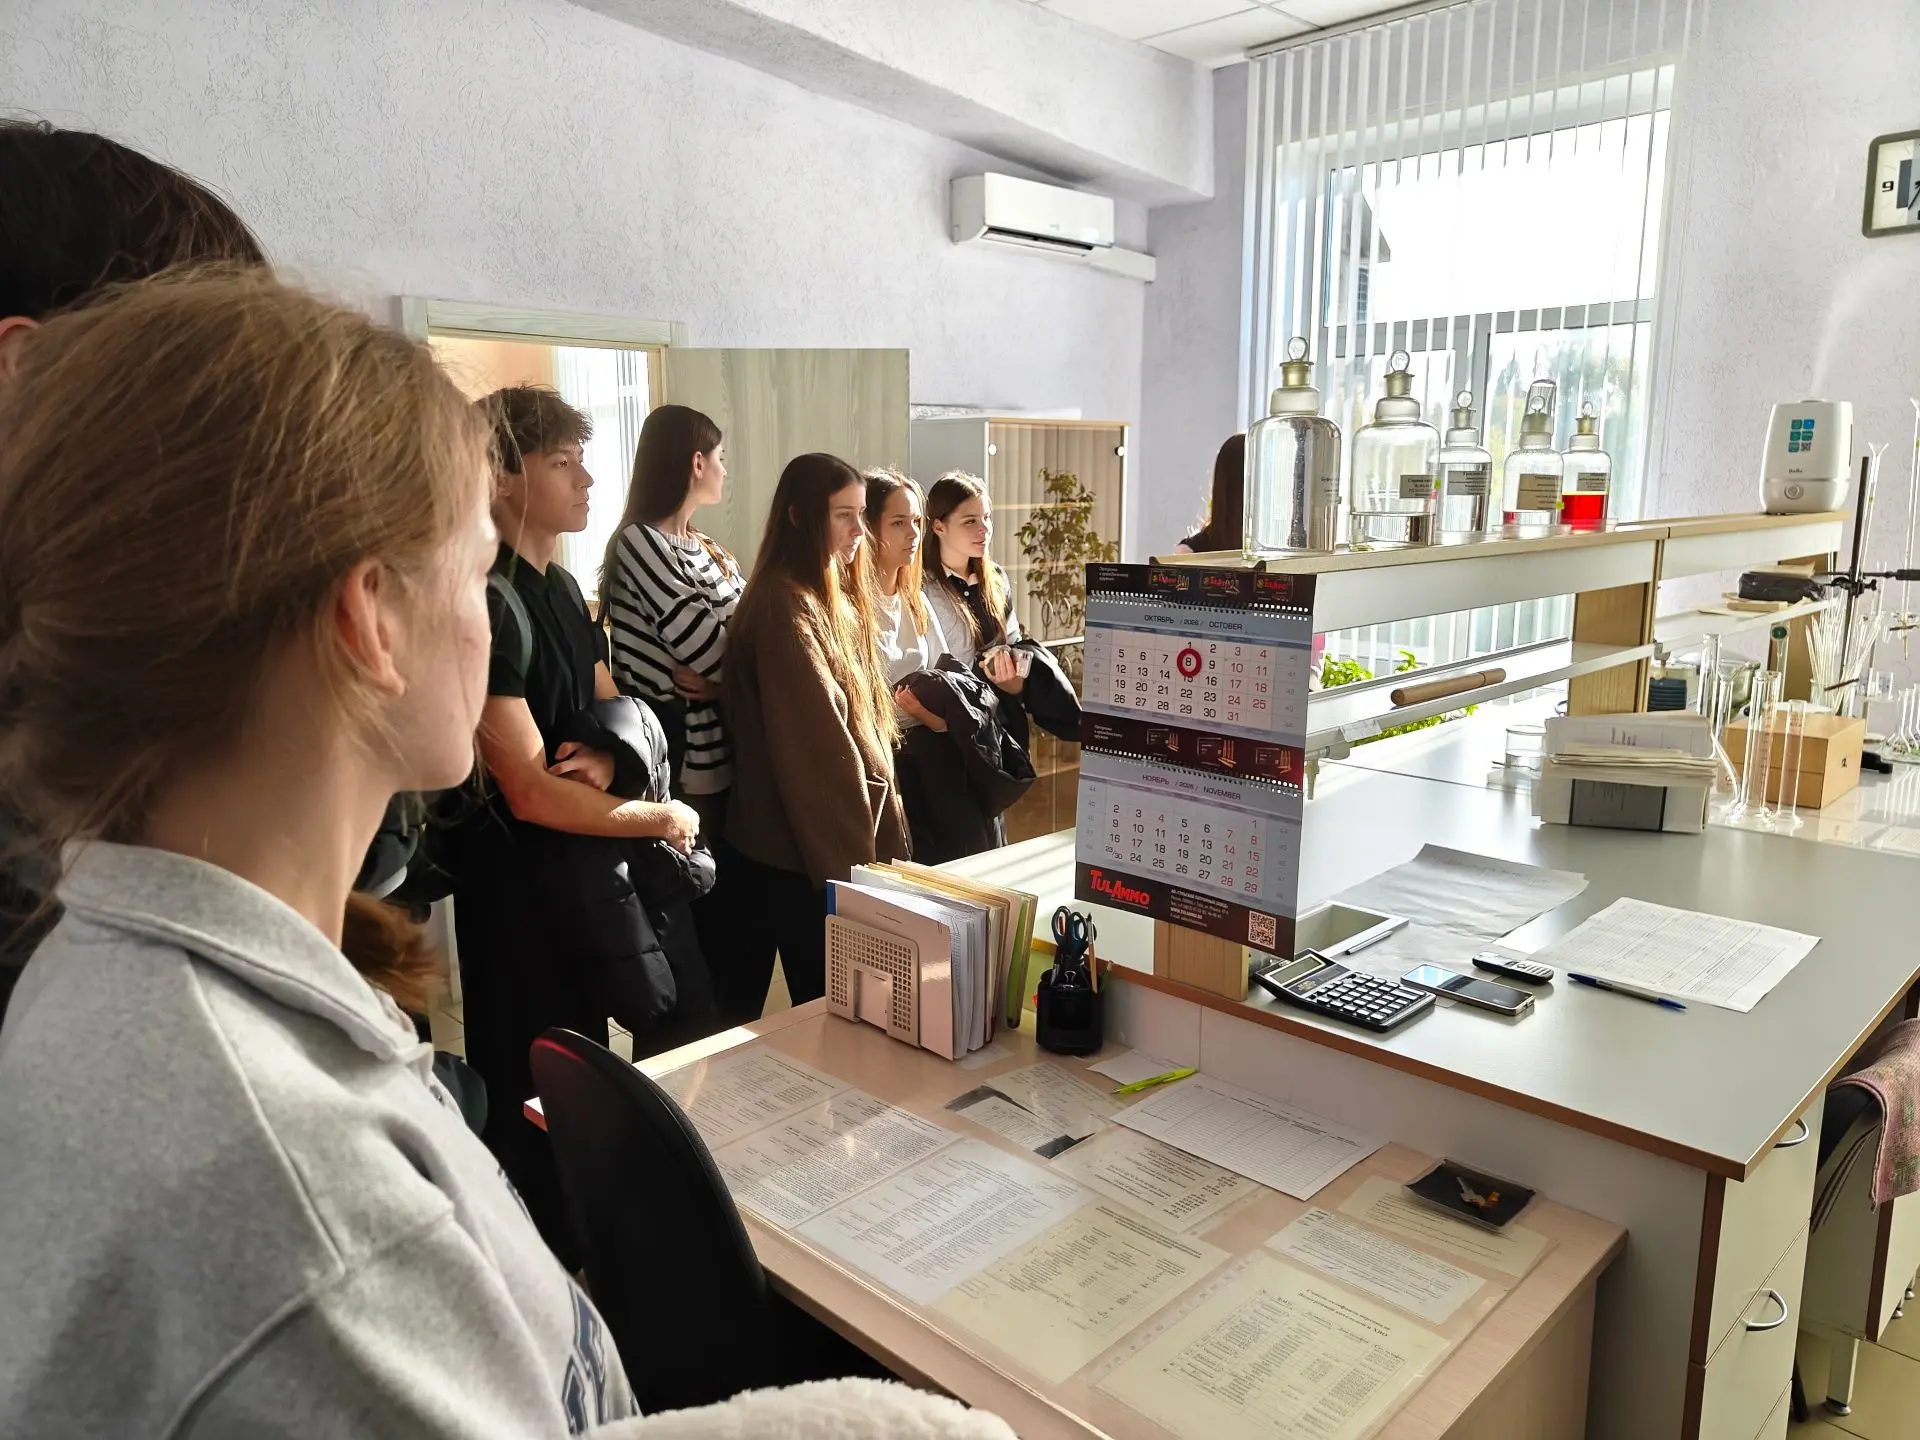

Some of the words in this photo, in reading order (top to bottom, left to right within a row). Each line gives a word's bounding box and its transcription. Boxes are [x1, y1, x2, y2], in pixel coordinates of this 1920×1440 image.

[1882, 181, 1894, 192] 9
[1144, 614, 1174, 624] ОКТЯБРЬ
[1209, 621, 1242, 631] OCTOBER
[1118, 649, 1124, 658] 5
[1140, 652, 1146, 660] 6
[1163, 654, 1169, 663] 7
[1185, 657, 1191, 666] 8
[1209, 660, 1215, 670] 9
[1231, 663, 1244, 673] 10
[1255, 666, 1267, 676] 11
[1210, 644, 1216, 653] 2
[1235, 647, 1241, 656] 3
[1260, 650, 1266, 659] 4
[1115, 664, 1126, 673] 12
[1137, 667, 1148, 676] 13
[1159, 669, 1170, 679] 14
[1205, 676, 1217, 686] 16
[1230, 679, 1242, 689] 17
[1255, 683, 1267, 693] 18
[1114, 694, 1125, 703] 26
[1135, 697, 1146, 706] 27
[1157, 701, 1169, 710] 28
[1180, 704, 1192, 714] 29
[1203, 708, 1216, 718] 30
[1227, 712, 1239, 721] 31
[1115, 679, 1126, 688] 19
[1136, 682, 1147, 691] 20
[1158, 685, 1169, 695] 21
[1180, 689, 1192, 698] 22
[1203, 692, 1216, 702] 23
[1228, 695, 1240, 705] 24
[1252, 699, 1266, 709] 25
[1142, 775, 1169, 785] НОЯБРЬ
[1204, 786, 1241, 800] NOVEMBER
[1113, 805, 1119, 813] 2
[1135, 809, 1141, 817] 3
[1158, 814, 1164, 822] 4
[1181, 819, 1187, 827] 5
[1204, 824, 1210, 833] 6
[1227, 829, 1233, 838] 7
[1251, 836, 1257, 845] 8
[1253, 820, 1257, 828] 1
[1112, 819, 1118, 827] 9
[1133, 824, 1144, 833] 10
[1155, 828, 1165, 838] 11
[1178, 834, 1189, 844] 12
[1201, 840, 1212, 849] 13
[1224, 845, 1235, 855] 14
[1248, 851, 1259, 861] 15
[1109, 833, 1120, 843] 16
[1131, 838, 1142, 848] 17
[1154, 843, 1165, 853] 18
[1177, 849, 1189, 859] 19
[1199, 854, 1212, 864] 20
[1222, 860, 1233, 870] 21
[1246, 866, 1258, 877] 22
[1130, 853, 1141, 862] 24
[1153, 858, 1165, 868] 25
[1175, 863, 1188, 874] 26
[1198, 870, 1211, 880] 27
[1221, 876, 1233, 886] 28
[1244, 882, 1257, 893] 29
